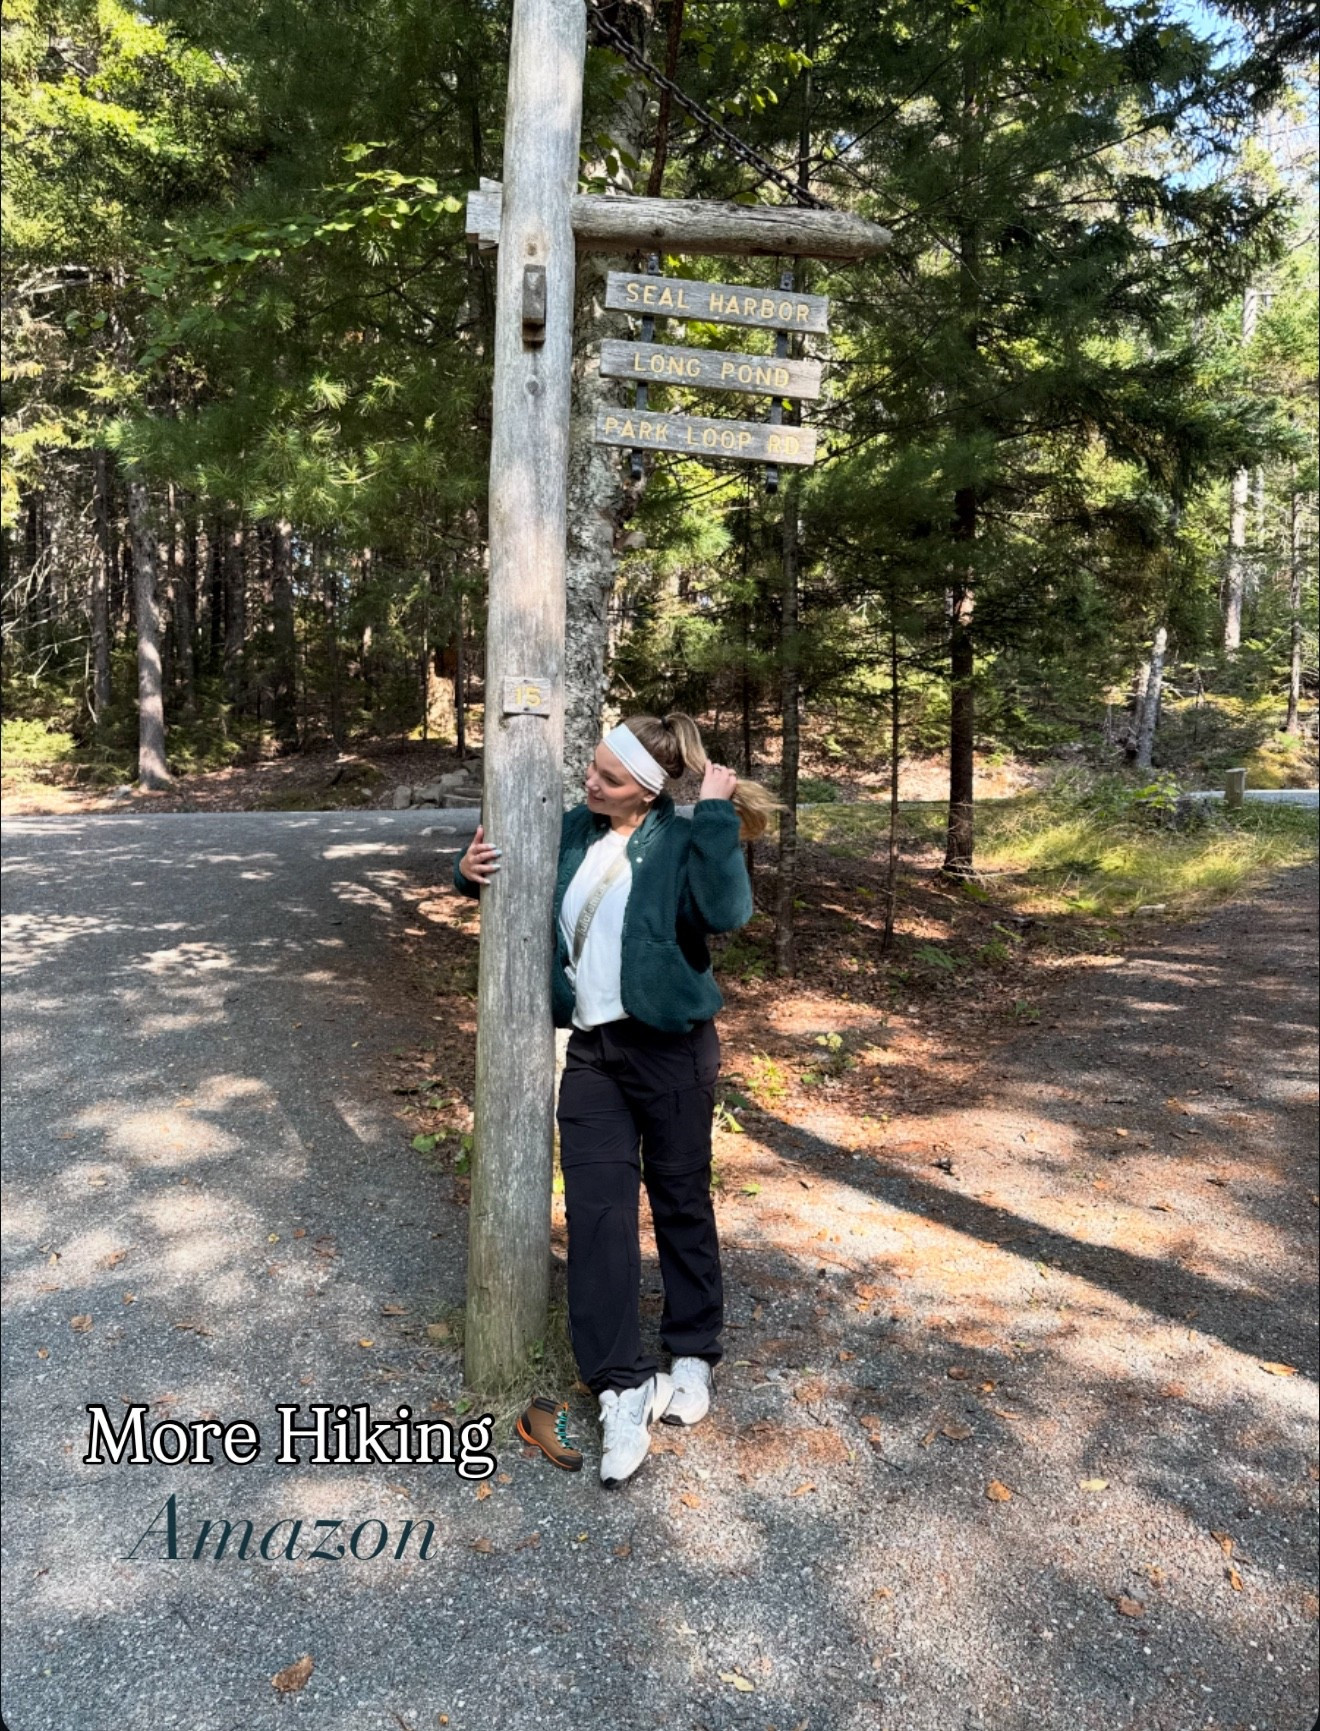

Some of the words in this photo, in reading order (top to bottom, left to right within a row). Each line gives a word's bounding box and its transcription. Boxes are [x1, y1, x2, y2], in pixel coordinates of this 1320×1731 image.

[626, 282, 689, 309] SEAL
[709, 292, 810, 322] HARBOR
[634, 351, 701, 377] LONG
[721, 361, 790, 388] POND
[604, 416, 668, 441] PARK
[687, 426, 752, 451] LOOP
[767, 435, 800, 455] RD
[515, 686, 541, 708] 15
